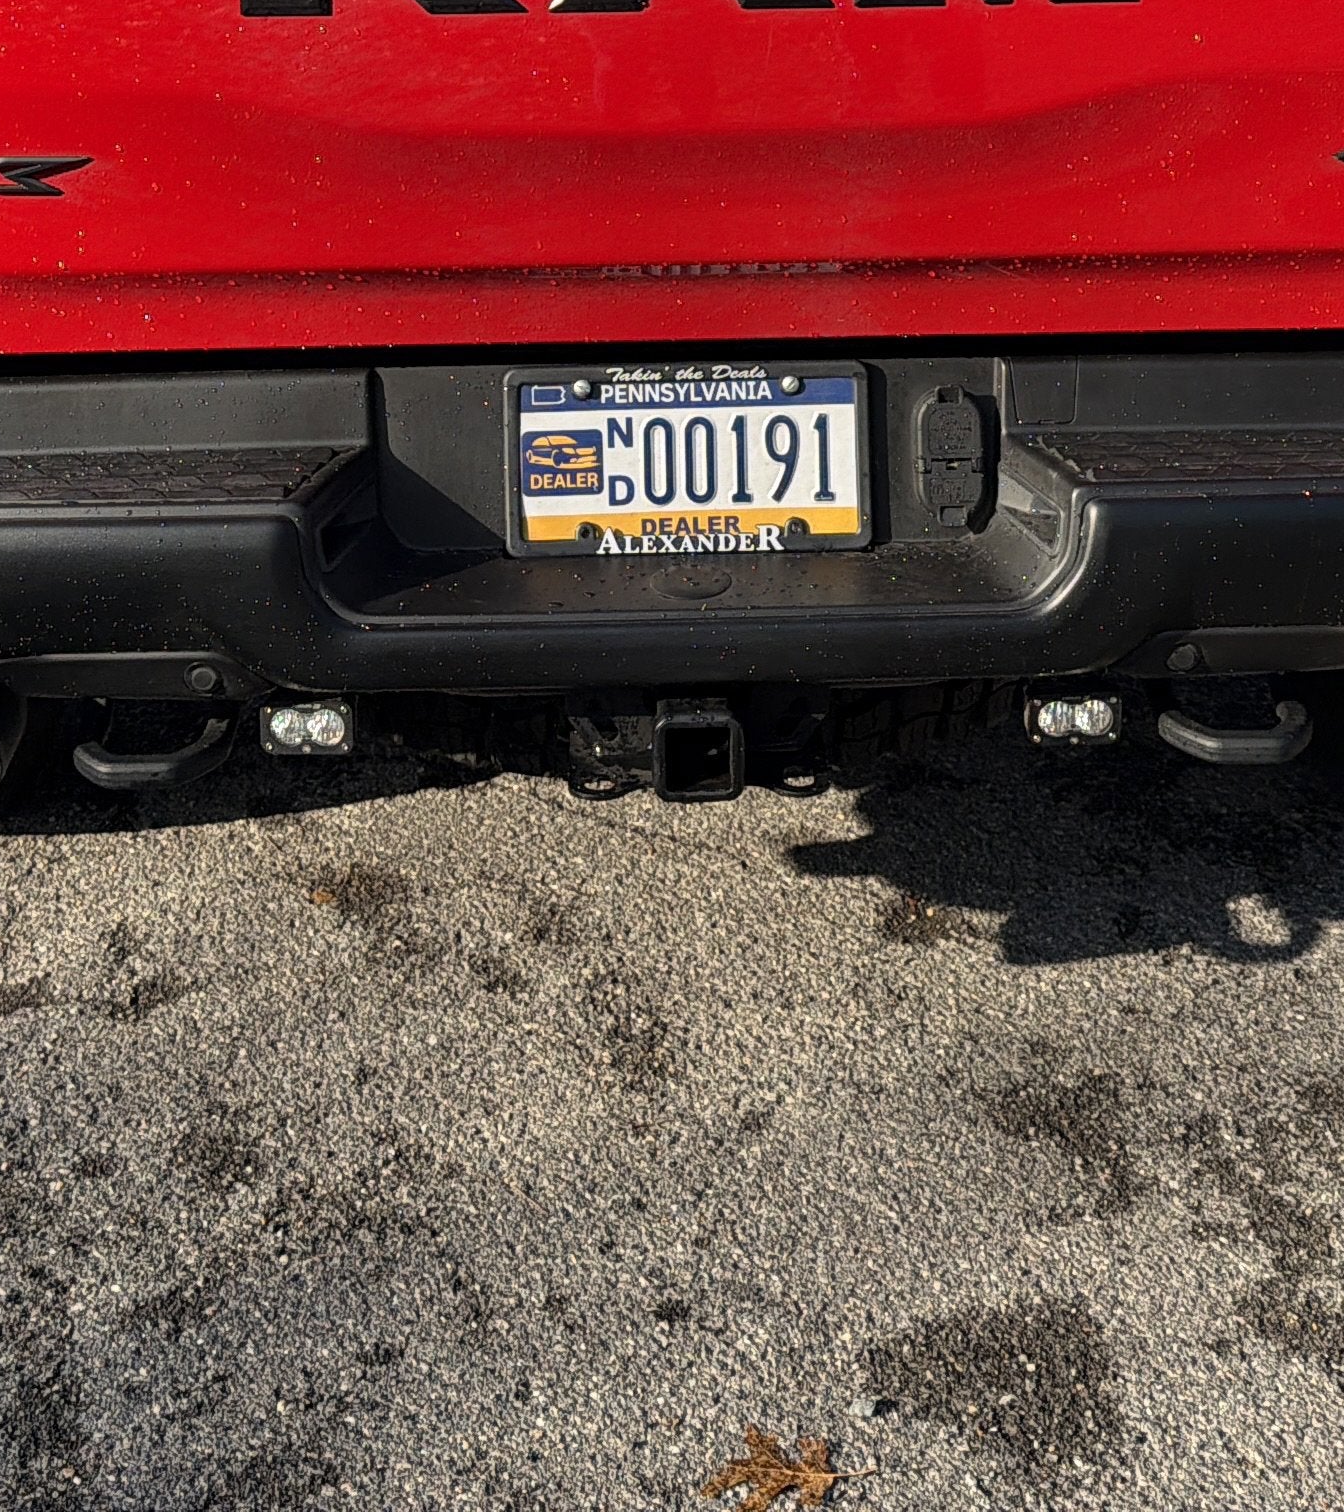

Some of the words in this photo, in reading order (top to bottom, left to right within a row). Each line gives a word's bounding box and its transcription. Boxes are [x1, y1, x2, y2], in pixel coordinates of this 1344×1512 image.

[606, 365, 670, 383] Takin'
[675, 366, 704, 380] the
[711, 364, 767, 379] Deals
[600, 380, 773, 404] PENNSYLVANIA
[530, 472, 599, 489] DEALER
[641, 515, 740, 535] DEALER
[596, 524, 785, 555] ALEXANDER
